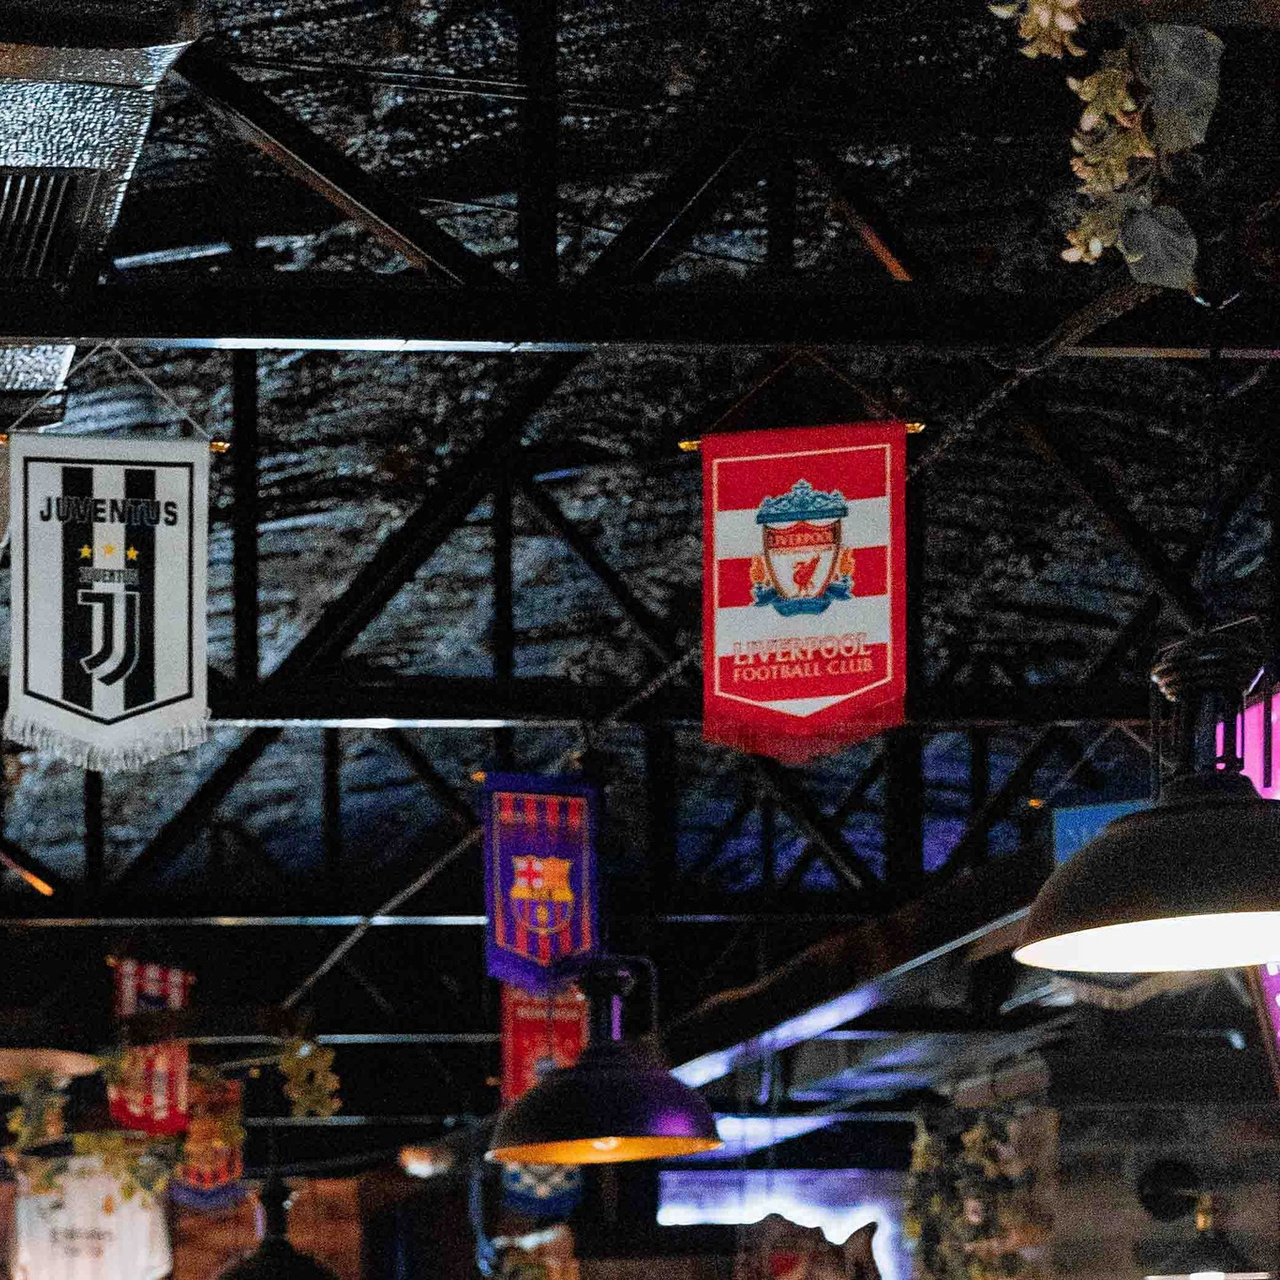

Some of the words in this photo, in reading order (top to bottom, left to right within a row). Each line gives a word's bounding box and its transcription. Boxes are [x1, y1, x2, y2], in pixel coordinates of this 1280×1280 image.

[40, 497, 178, 526] JUVENTUS
[733, 632, 872, 665] LIVERPOOL
[733, 662, 821, 682] FOOTBALL
[827, 657, 873, 675] CLUB
